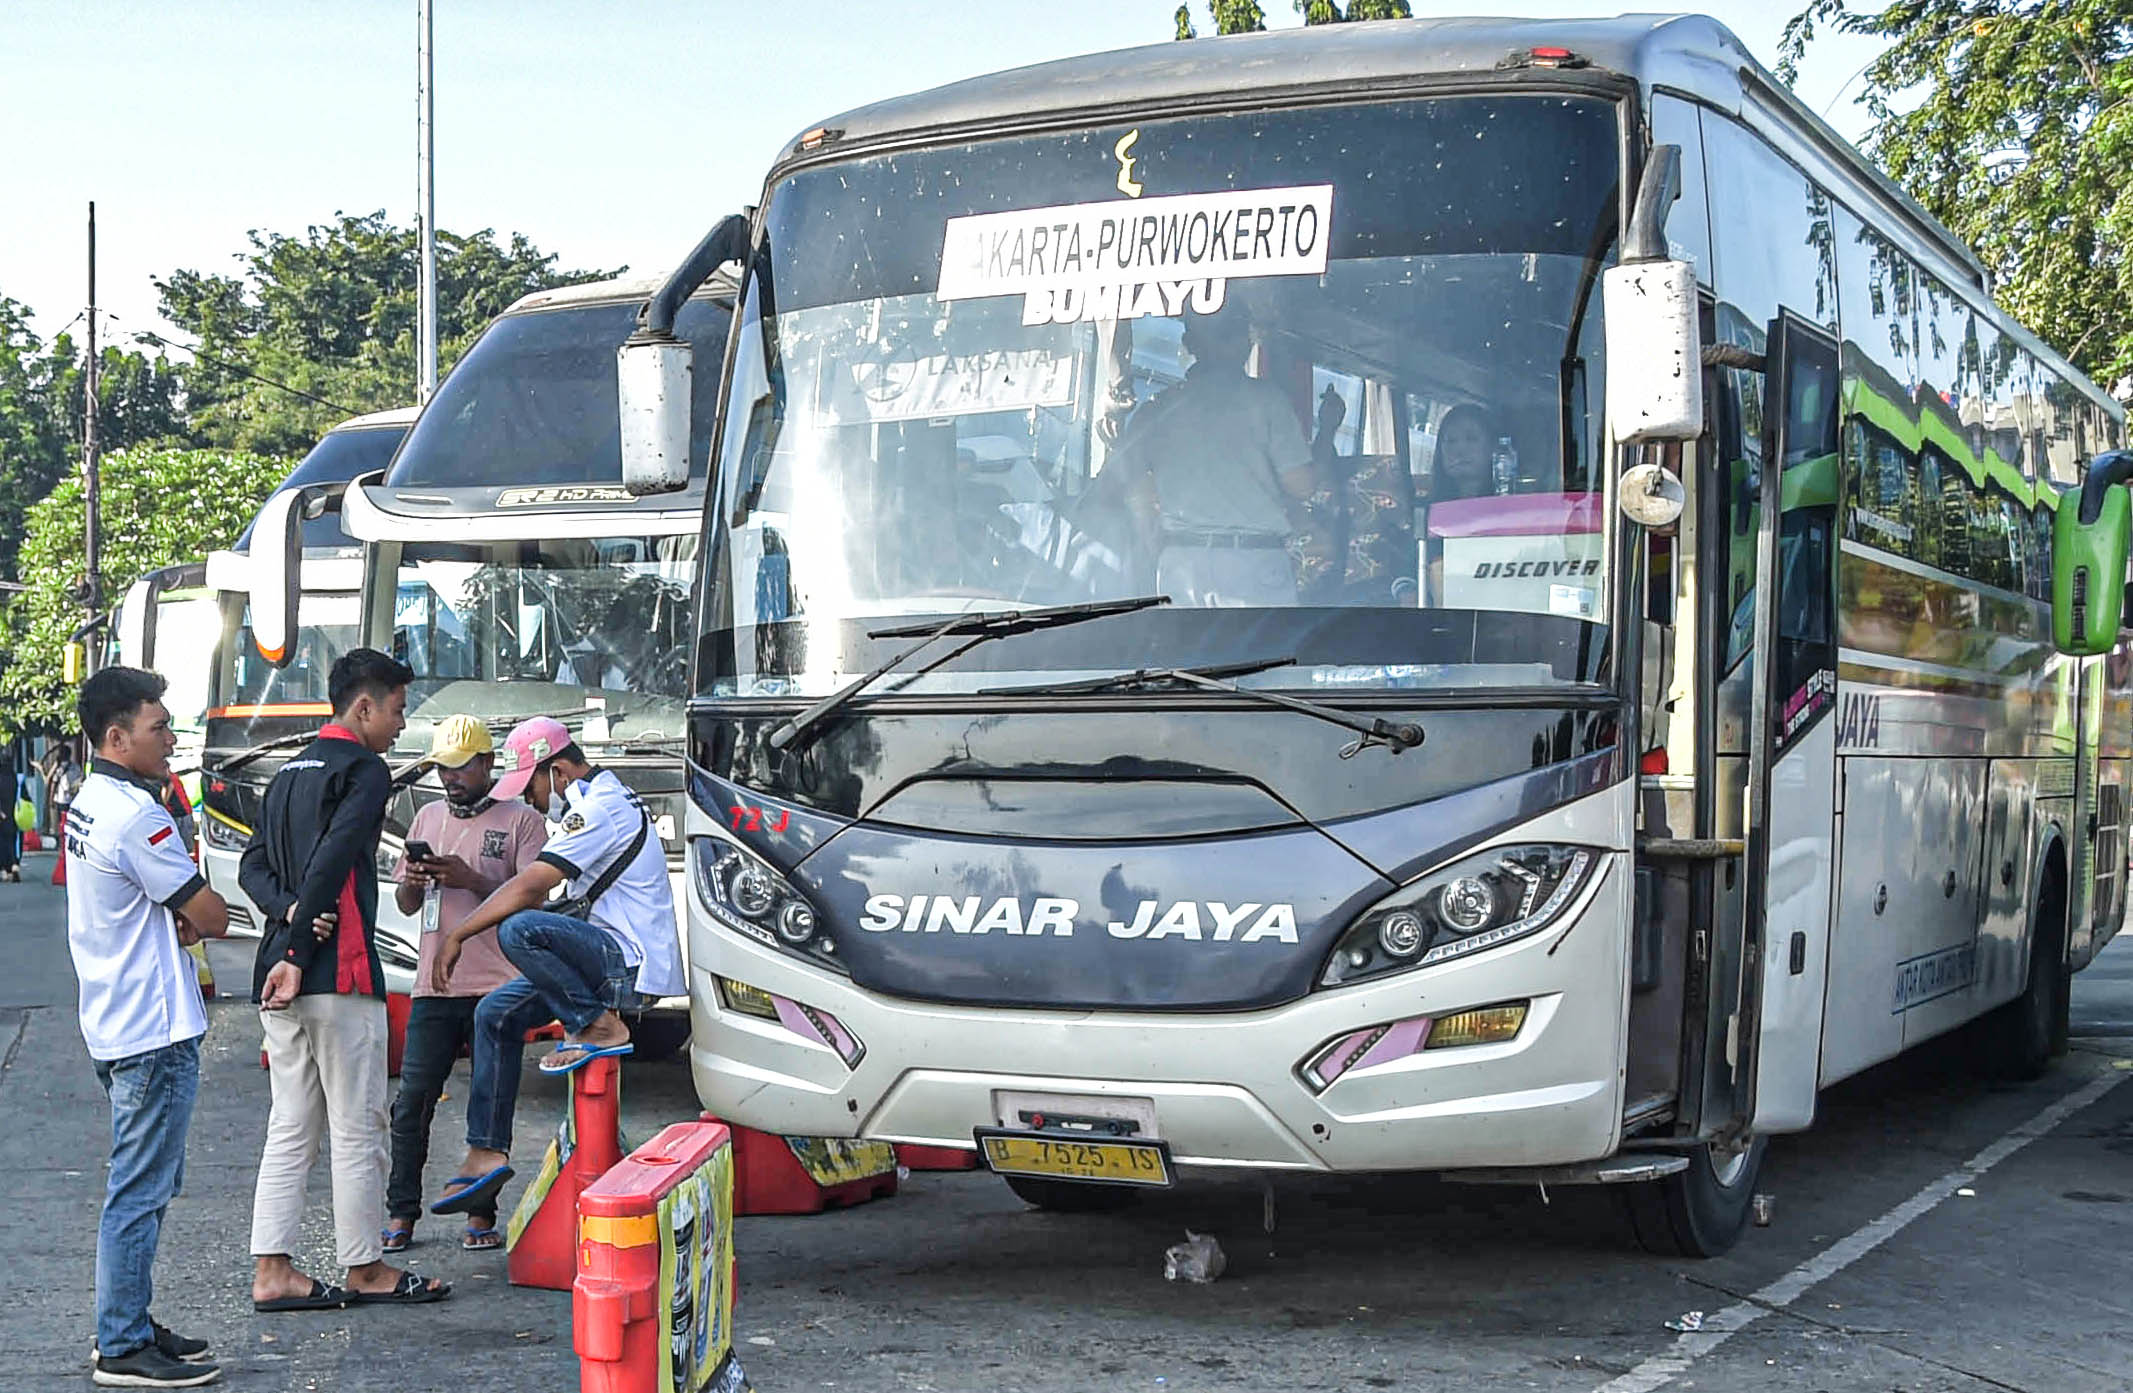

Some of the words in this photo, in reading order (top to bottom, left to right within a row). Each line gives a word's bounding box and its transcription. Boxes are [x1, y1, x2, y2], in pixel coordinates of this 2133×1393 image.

[962, 203, 1318, 281] AKARTA-PURWOKERTO
[1473, 559, 1600, 579] DISCOVER
[729, 806, 763, 832] 72
[771, 809, 790, 832] J
[859, 894, 1081, 937] SINAR
[1106, 899, 1300, 944] JAYA
[994, 1139, 1010, 1161] B
